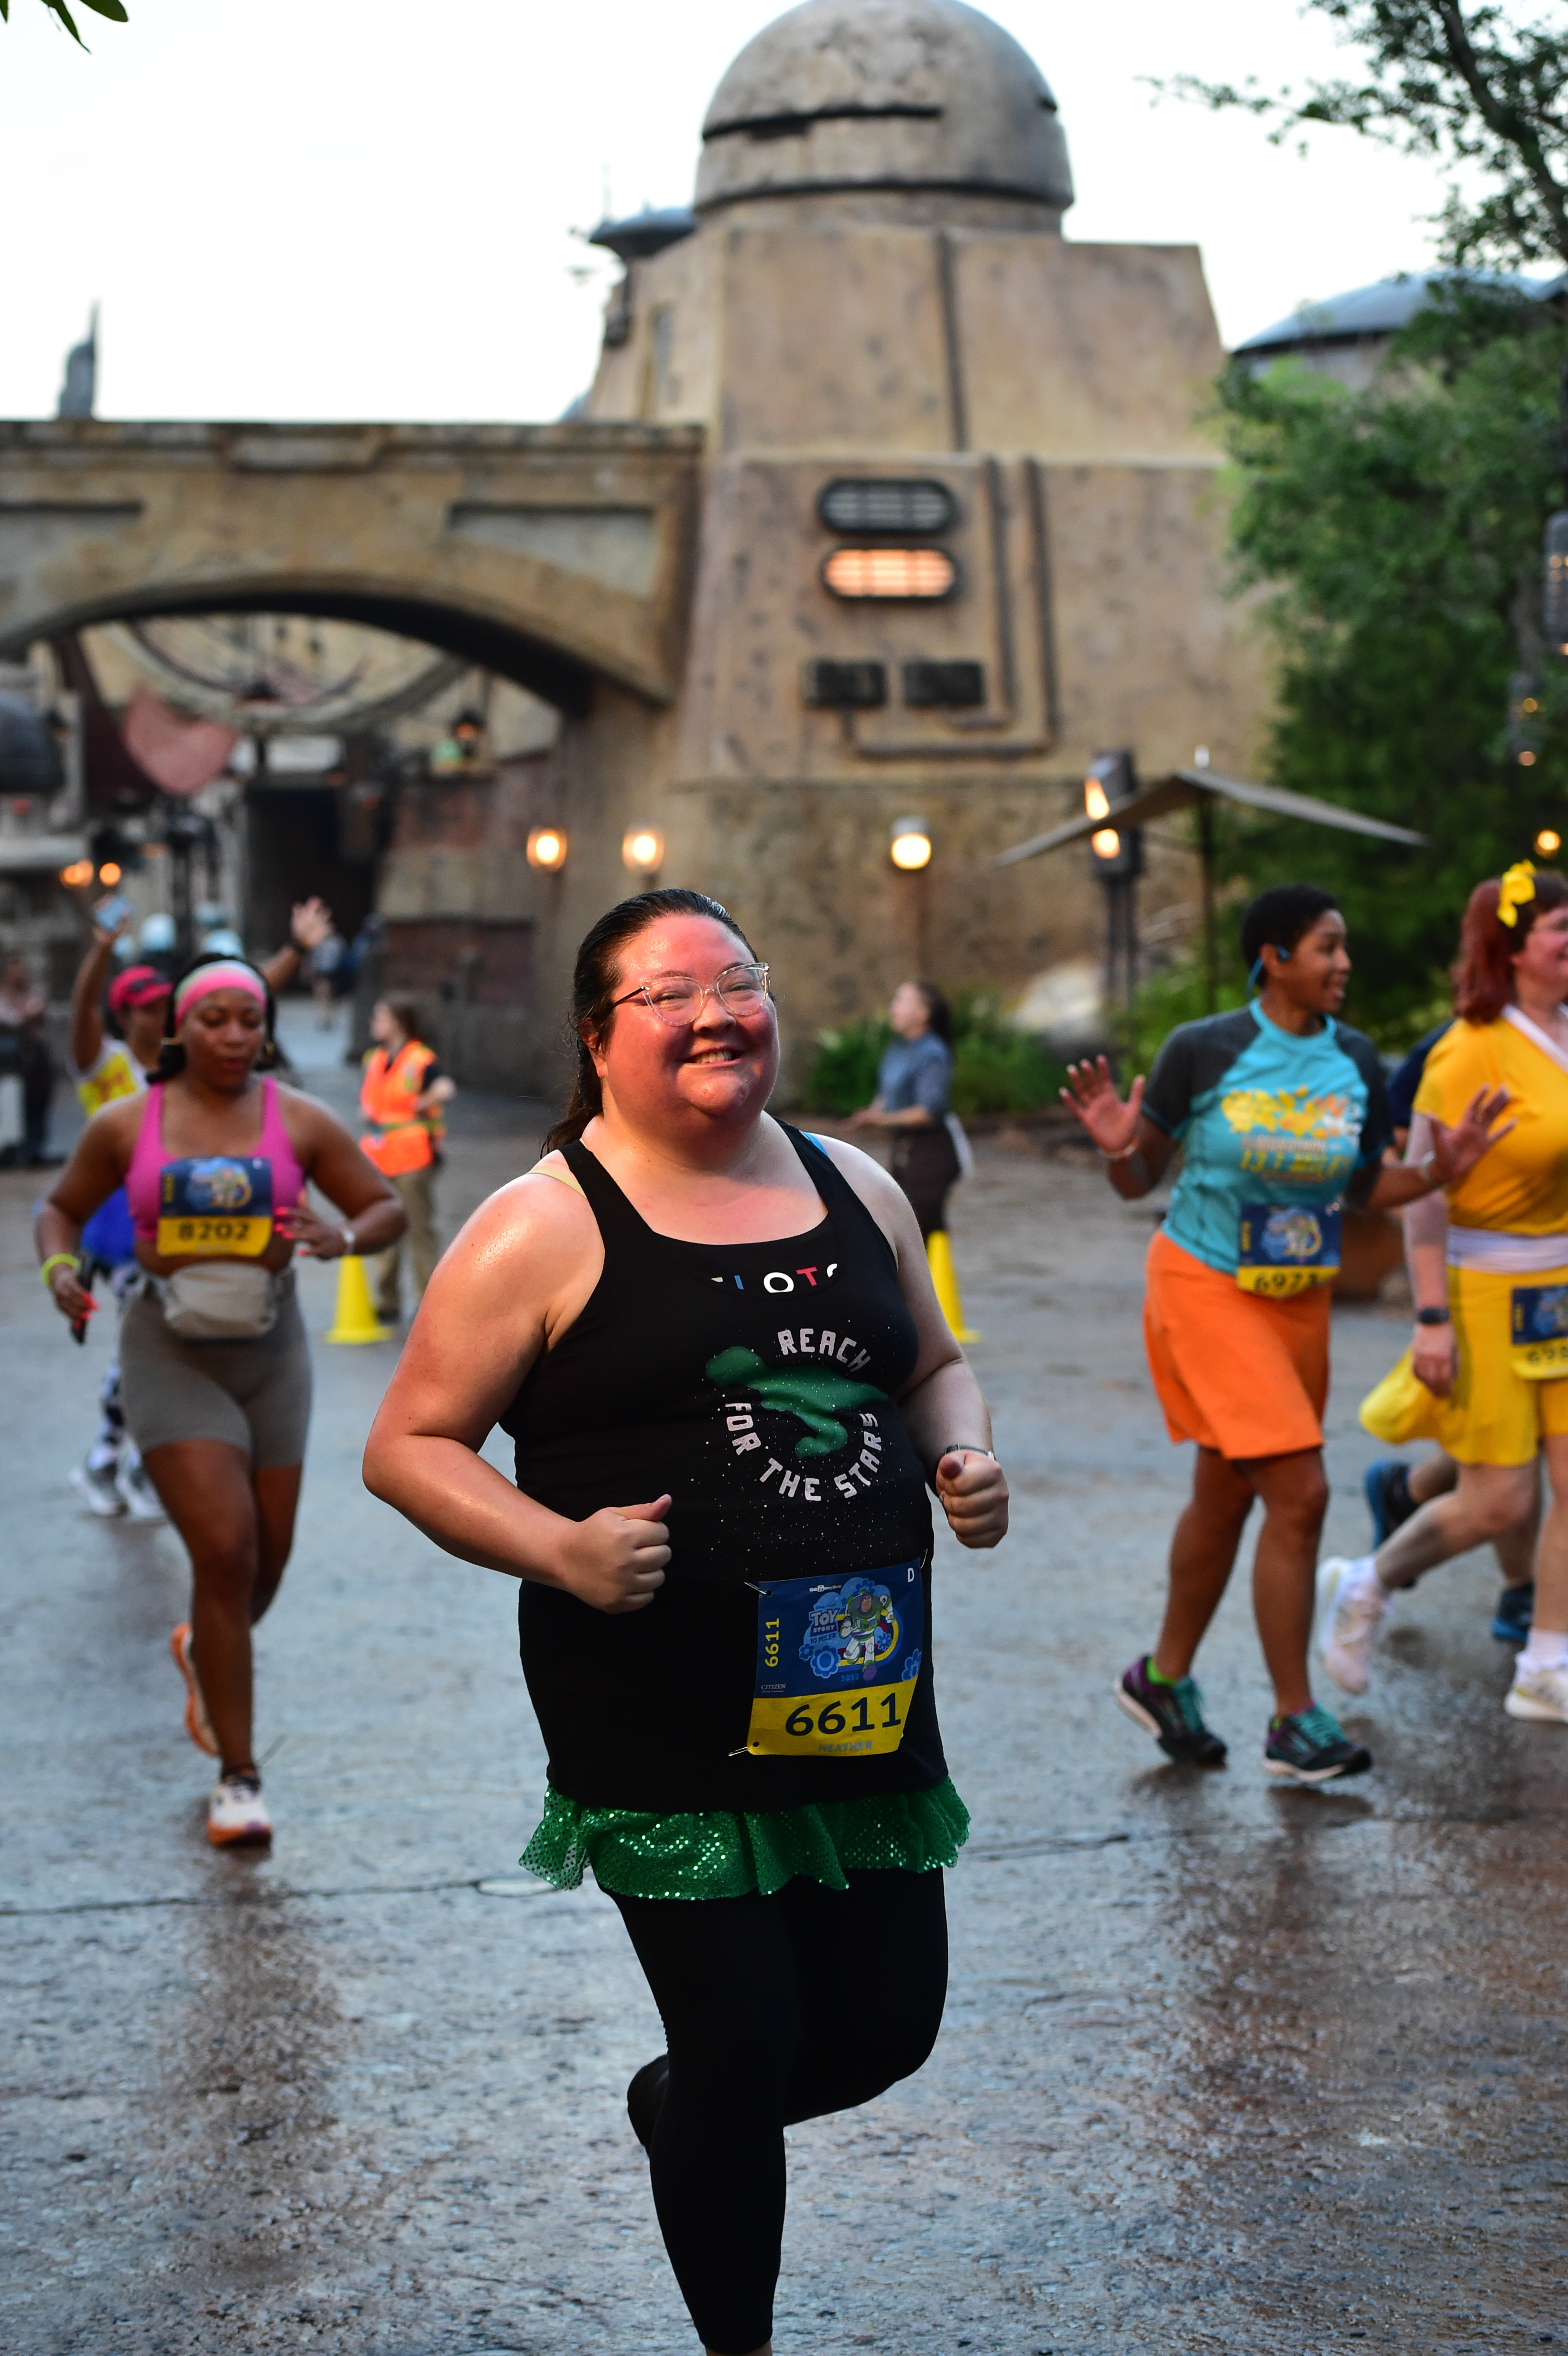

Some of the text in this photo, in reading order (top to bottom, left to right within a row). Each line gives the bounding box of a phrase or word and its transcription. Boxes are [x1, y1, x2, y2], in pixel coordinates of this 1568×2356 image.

[178, 1221, 250, 1241] 8202
[777, 1328, 871, 1373] REACH
[725, 1403, 882, 1502] FOR THE STARS
[907, 1567, 915, 1582] D
[810, 1609, 839, 1626] TOY
[813, 1625, 836, 1633] STORY
[818, 1632, 837, 1643] MILER
[764, 1618, 780, 1667] 6611
[785, 1692, 902, 1736] 6611
[818, 1740, 872, 1752] HEATHER
